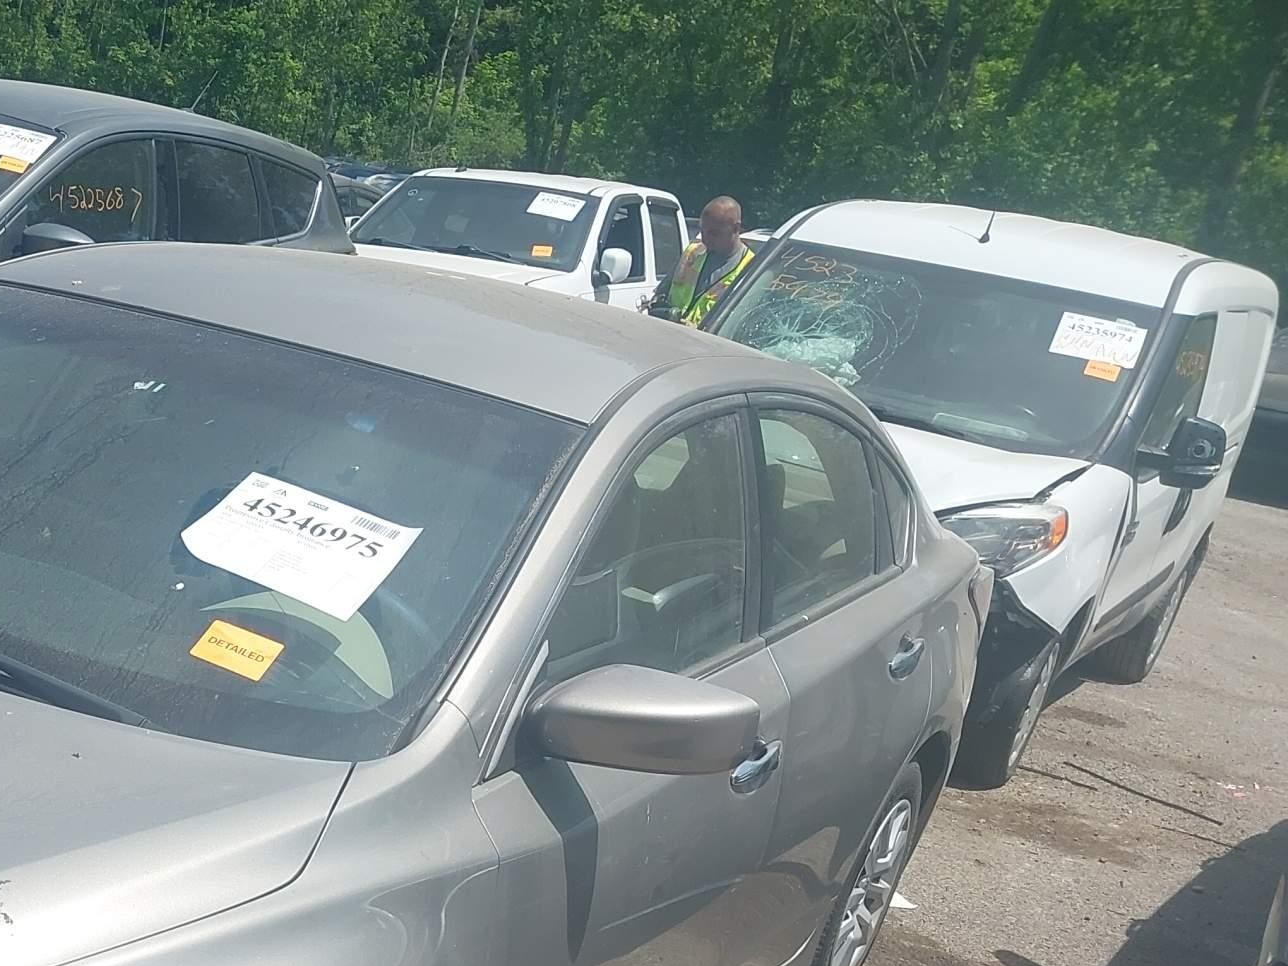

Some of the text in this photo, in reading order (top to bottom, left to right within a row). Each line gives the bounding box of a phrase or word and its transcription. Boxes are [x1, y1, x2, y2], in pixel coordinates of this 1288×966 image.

[49, 184, 143, 223] 45225687
[781, 247, 857, 284] 4523
[243, 498, 384, 558] 45246975
[207, 635, 265, 663] DETAILED
